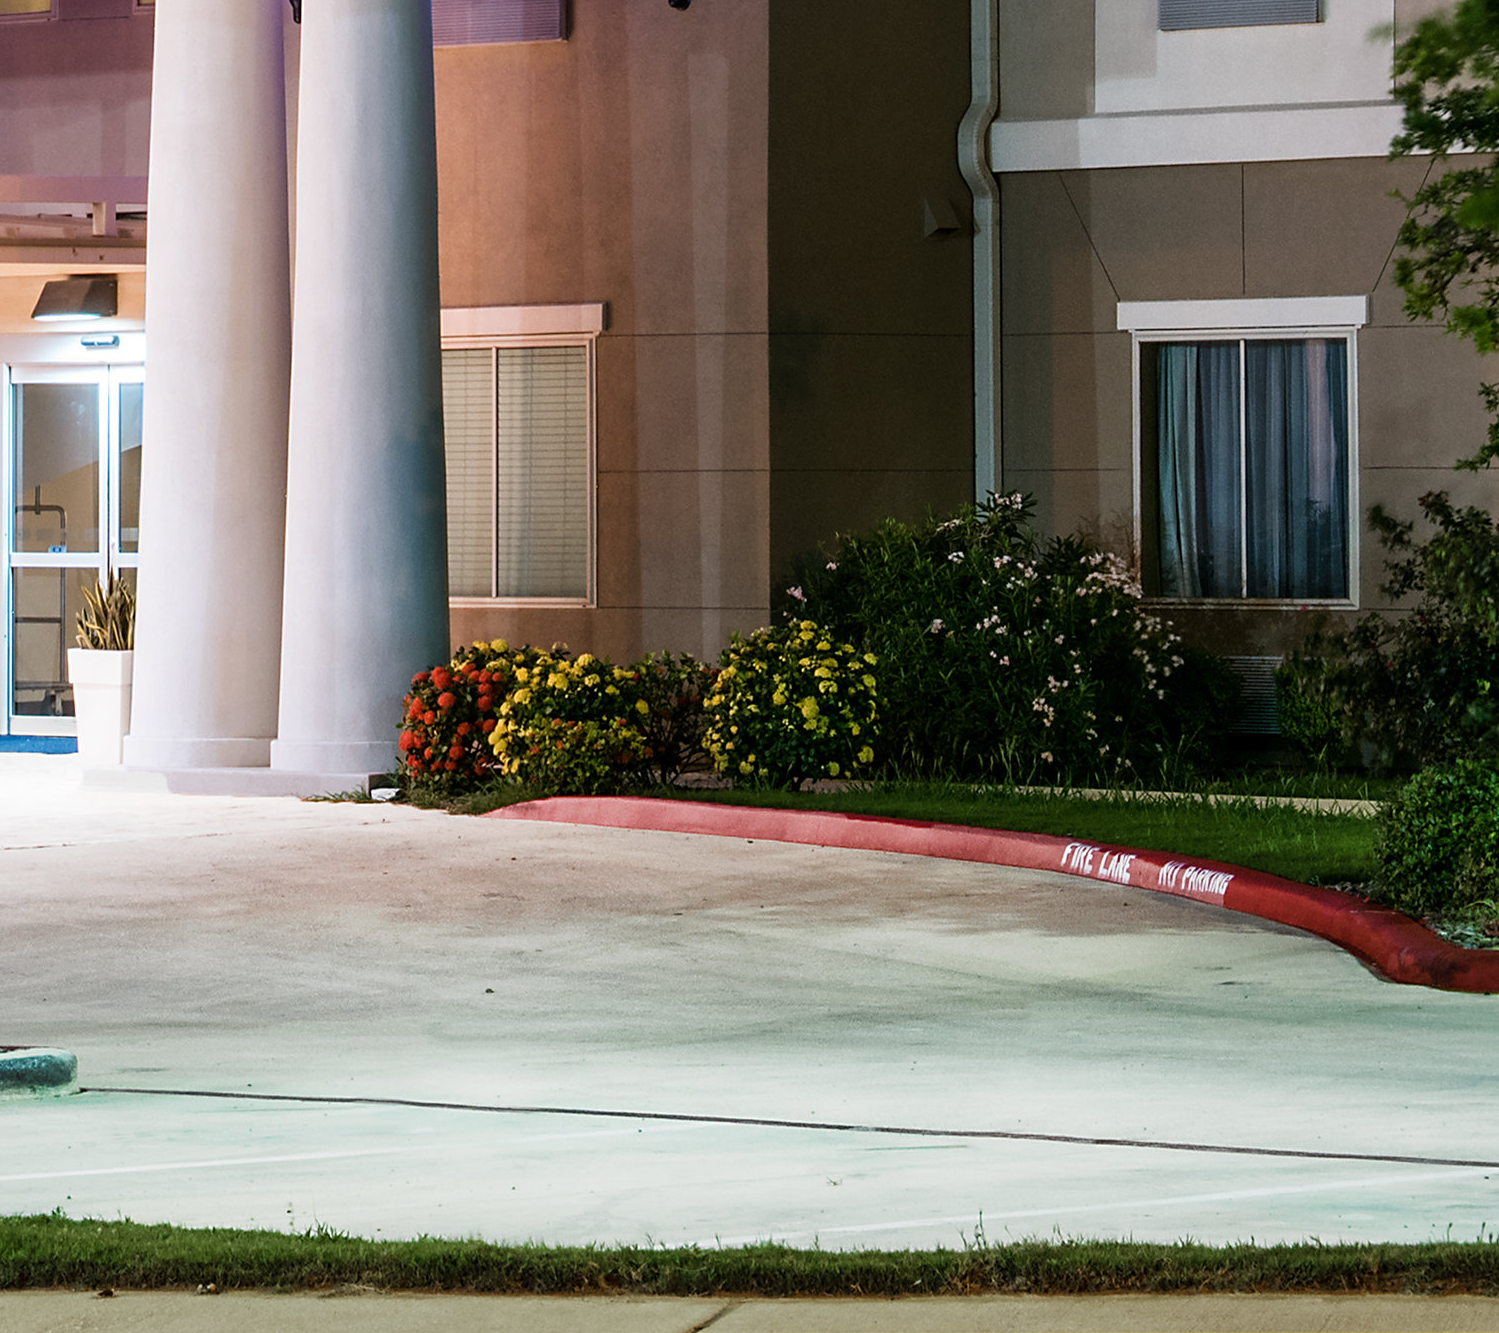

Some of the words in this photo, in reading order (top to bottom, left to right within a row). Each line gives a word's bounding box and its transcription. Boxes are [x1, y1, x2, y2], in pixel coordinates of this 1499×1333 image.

[1060, 842, 1101, 874] FIRE
[1098, 850, 1137, 884] LANE
[1181, 866, 1235, 895] PARKING
